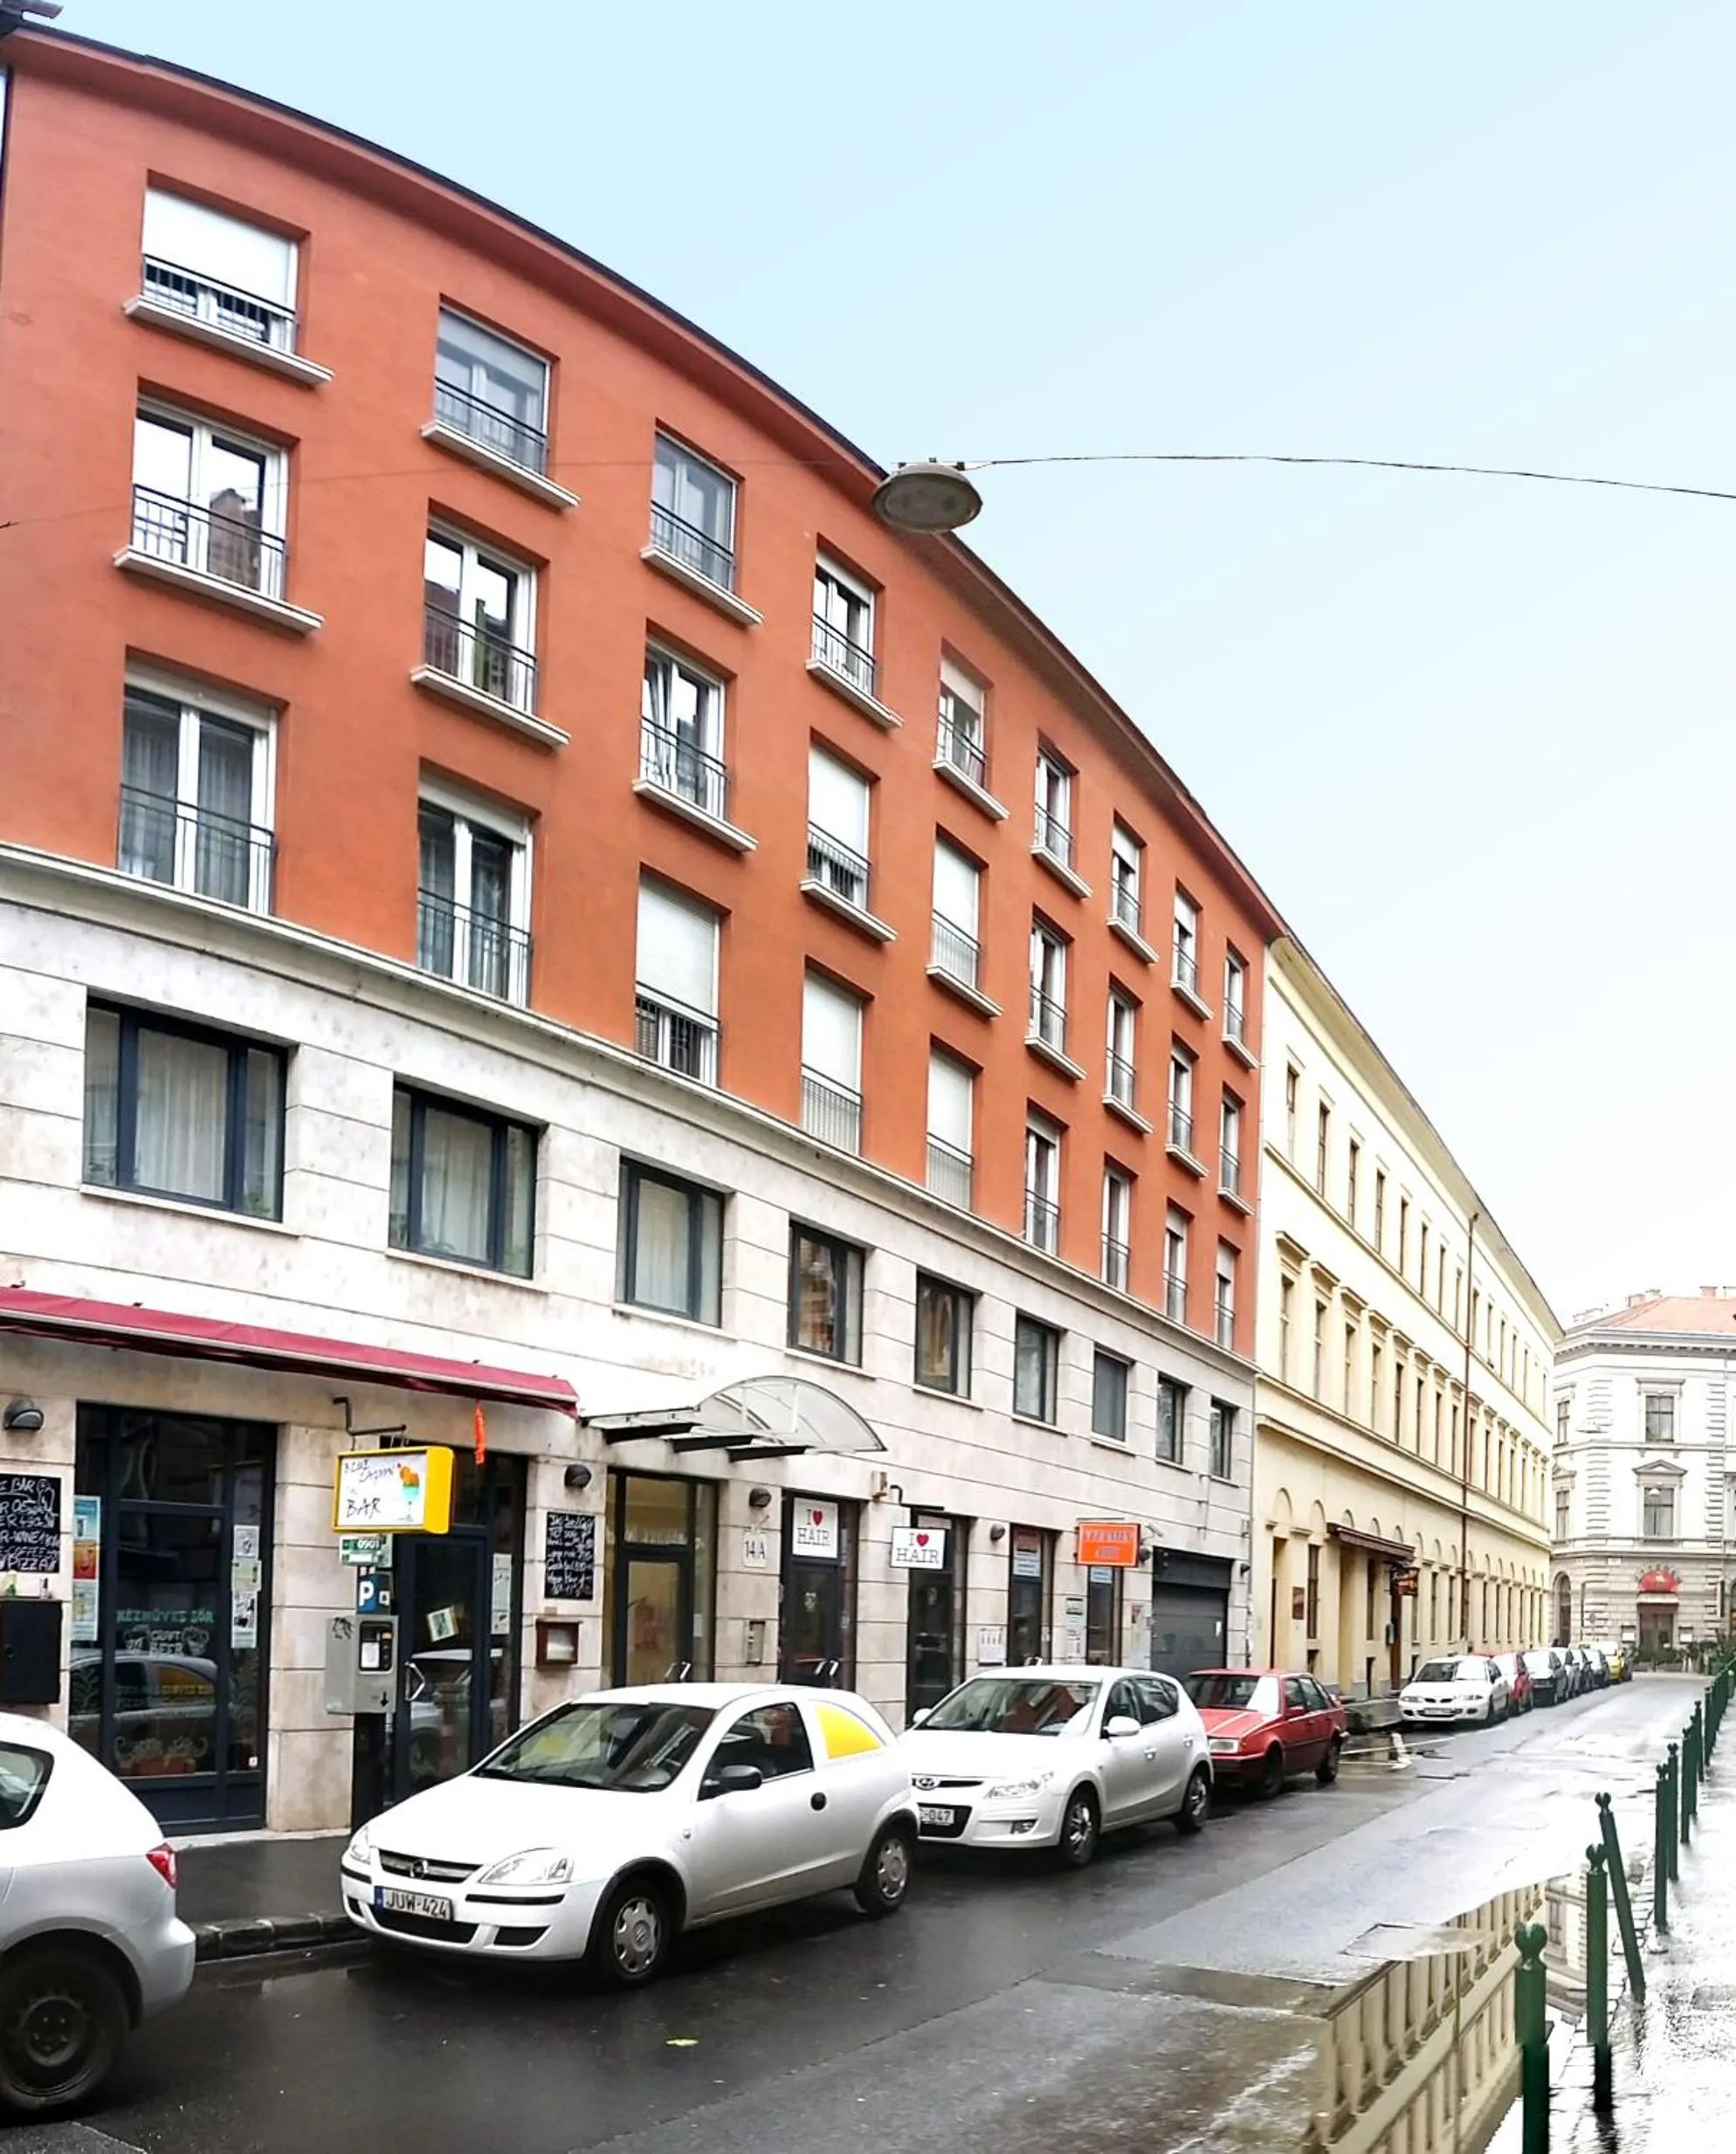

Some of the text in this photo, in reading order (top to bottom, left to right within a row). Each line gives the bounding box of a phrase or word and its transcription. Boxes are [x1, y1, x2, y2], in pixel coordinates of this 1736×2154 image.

[346, 1497, 382, 1519] BAR
[357, 1539, 380, 1549] 0901
[796, 1527, 830, 1546] HAIR
[745, 1540, 766, 1559] 14A
[895, 1547, 940, 1564] HAIR
[358, 1580, 374, 1607] P
[387, 1891, 446, 1918] JUW-424
